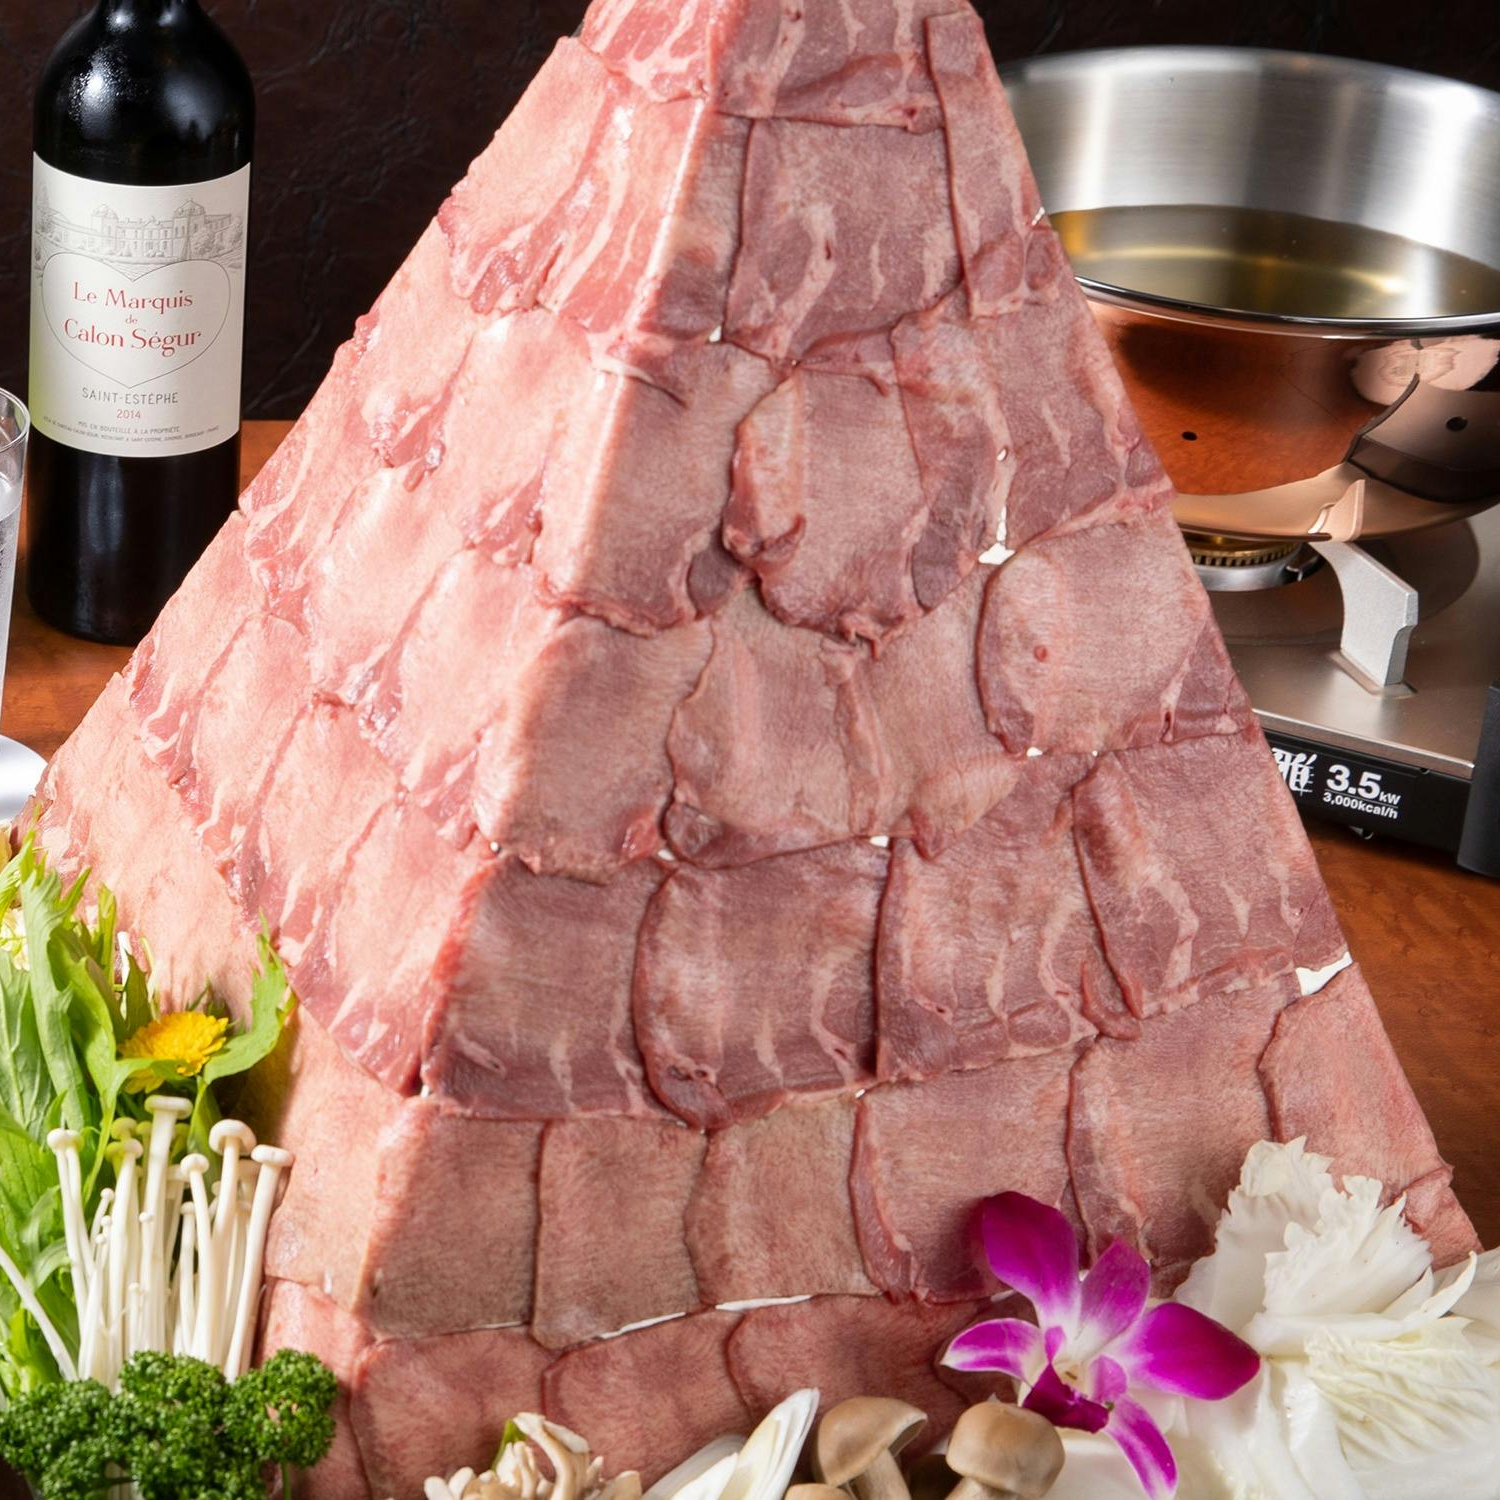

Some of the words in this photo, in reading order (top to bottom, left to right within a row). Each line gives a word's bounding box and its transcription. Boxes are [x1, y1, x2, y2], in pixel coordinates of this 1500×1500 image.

[72, 281, 98, 302] Le
[104, 288, 194, 315] Marquis
[124, 314, 139, 325] de
[64, 318, 125, 348] Calon
[130, 328, 203, 358] Ségur
[116, 409, 142, 420] 2014
[1322, 791, 1399, 820] 3,000kcal/h
